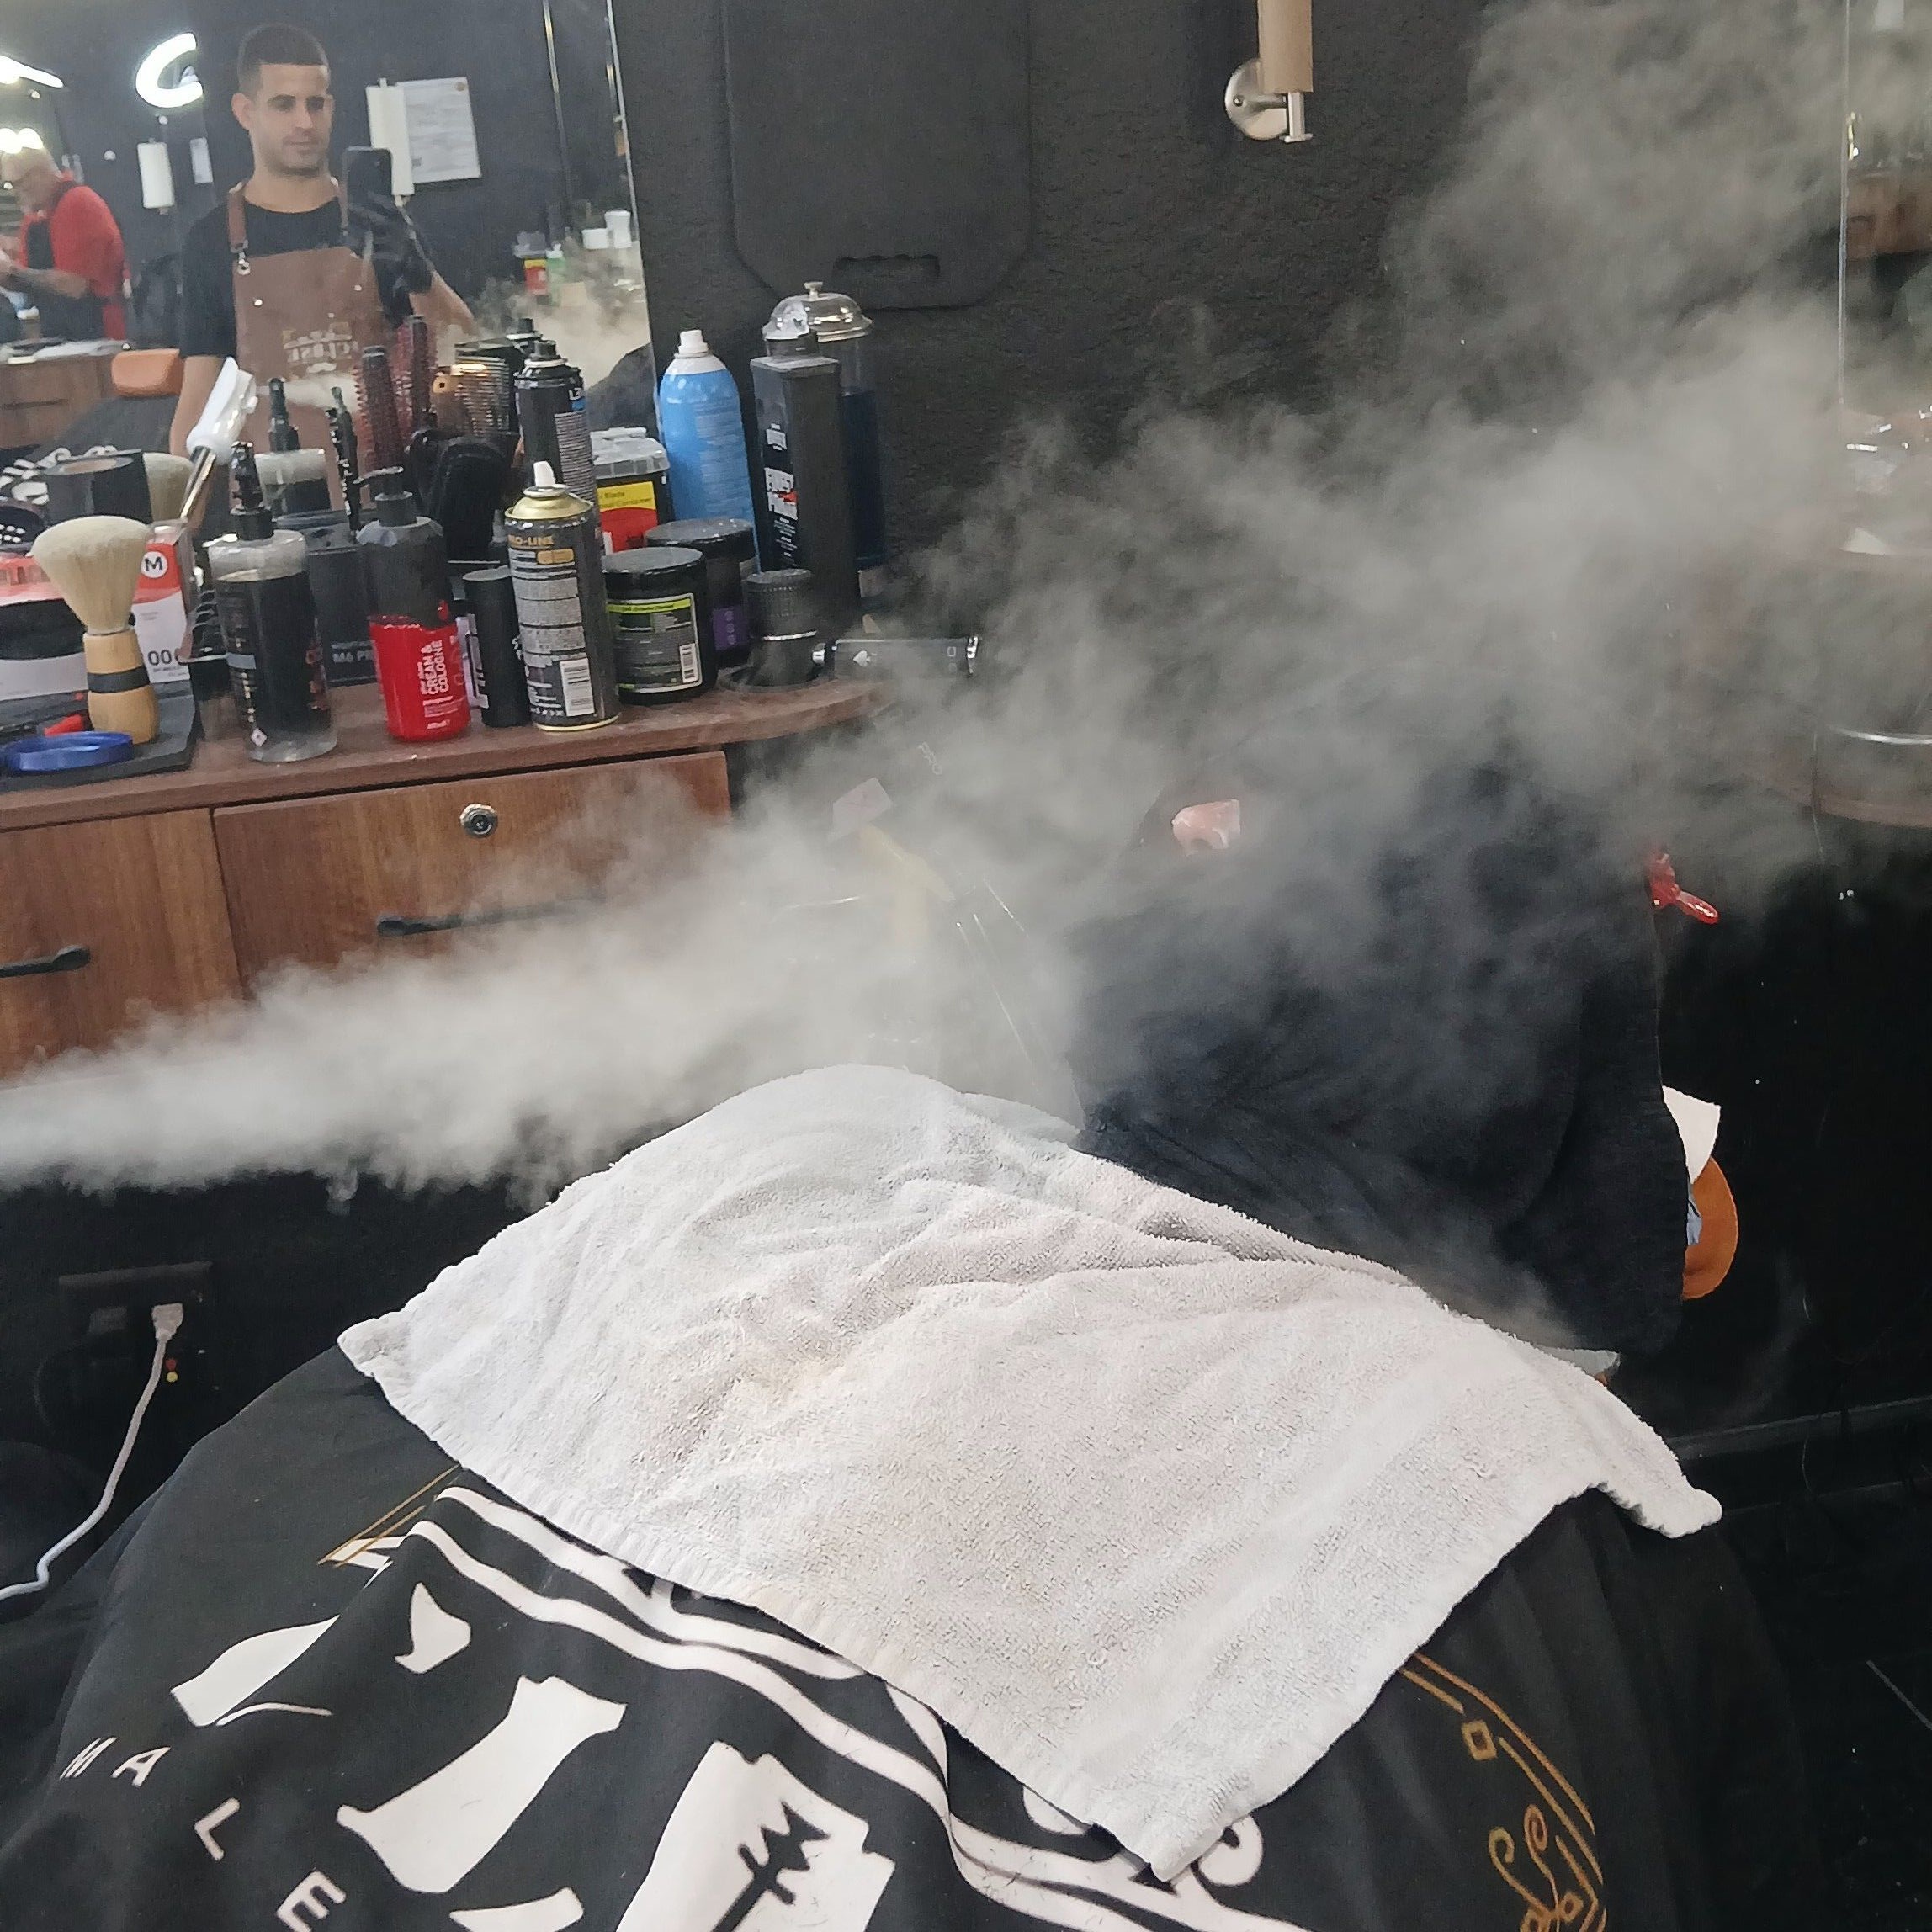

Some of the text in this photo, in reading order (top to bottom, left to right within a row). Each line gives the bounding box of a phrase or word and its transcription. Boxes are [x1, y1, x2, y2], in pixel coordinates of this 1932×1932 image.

[145, 556, 163, 571] M
[422, 655, 438, 695] CREAM
[432, 640, 449, 693] COLOGNE
